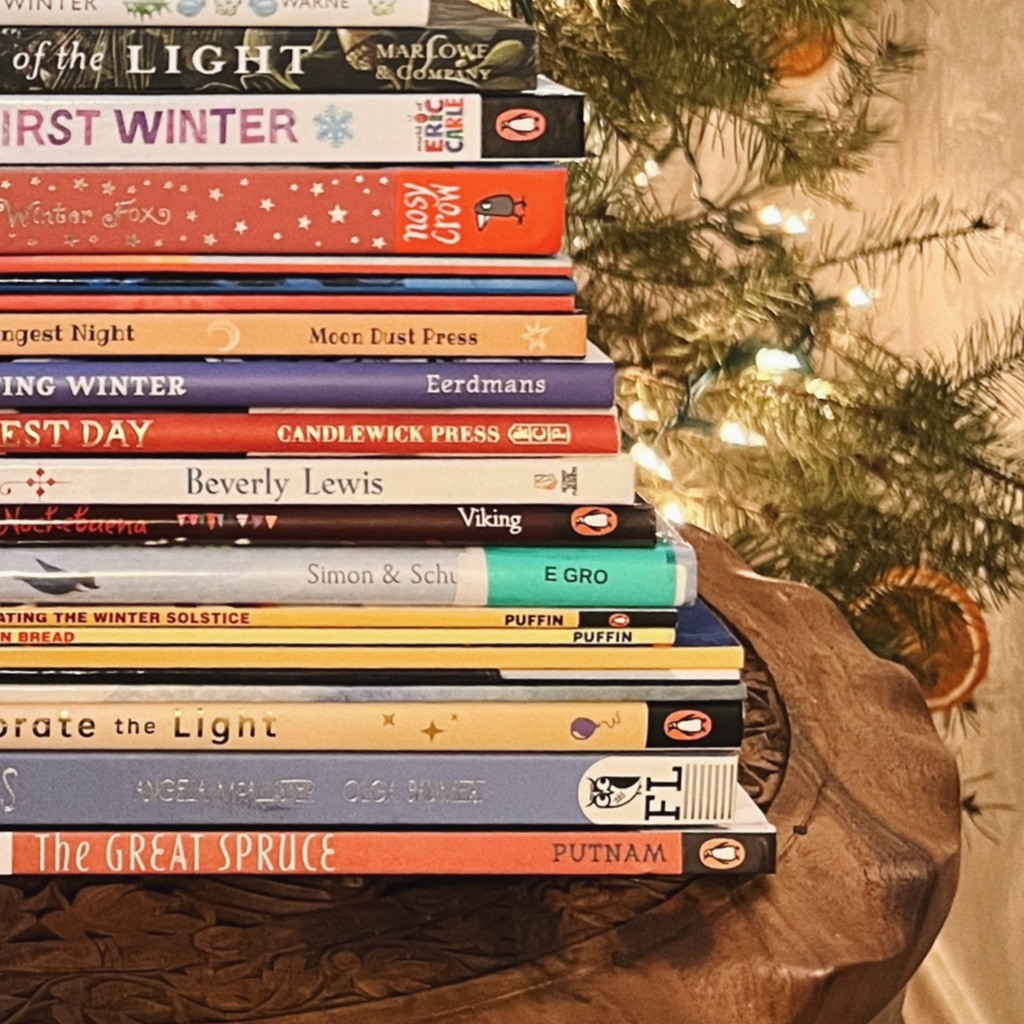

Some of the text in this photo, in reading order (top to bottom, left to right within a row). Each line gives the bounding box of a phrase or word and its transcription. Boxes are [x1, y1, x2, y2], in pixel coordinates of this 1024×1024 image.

[12, 40, 46, 77] of
[56, 40, 104, 71] the
[127, 44, 313, 74] LIGHT
[376, 36, 489, 61] MARLOWE
[114, 109, 298, 144] WINTER
[425, 99, 444, 152] ERIC
[445, 98, 464, 153] CARLE
[102, 199, 170, 227] Fox
[403, 182, 440, 242] nosy
[71, 324, 134, 346] Night
[310, 328, 478, 345] Moon Dust Press
[66, 376, 186, 395] WINTER
[426, 375, 545, 394] Eerdmans
[80, 420, 153, 447] DAY
[278, 426, 500, 443] CANDLEWICK PRESS
[187, 468, 383, 502] Beverly Lewis
[458, 508, 522, 534] Viking
[307, 564, 374, 585] Simon
[383, 564, 400, 584] &
[545, 566, 608, 584] E GRO
[54, 613, 88, 624] THE
[93, 613, 160, 624] WINTER
[167, 613, 249, 624] SOLSTICE
[505, 615, 564, 626] PUFFIN
[18, 632, 75, 643] BREAD
[573, 632, 632, 643] PUFFIN
[114, 718, 156, 734] the
[173, 708, 277, 745] Light
[645, 766, 682, 820] FL
[35, 833, 336, 872] The GREAT SPRUCE
[553, 843, 668, 863] PUTNAM
